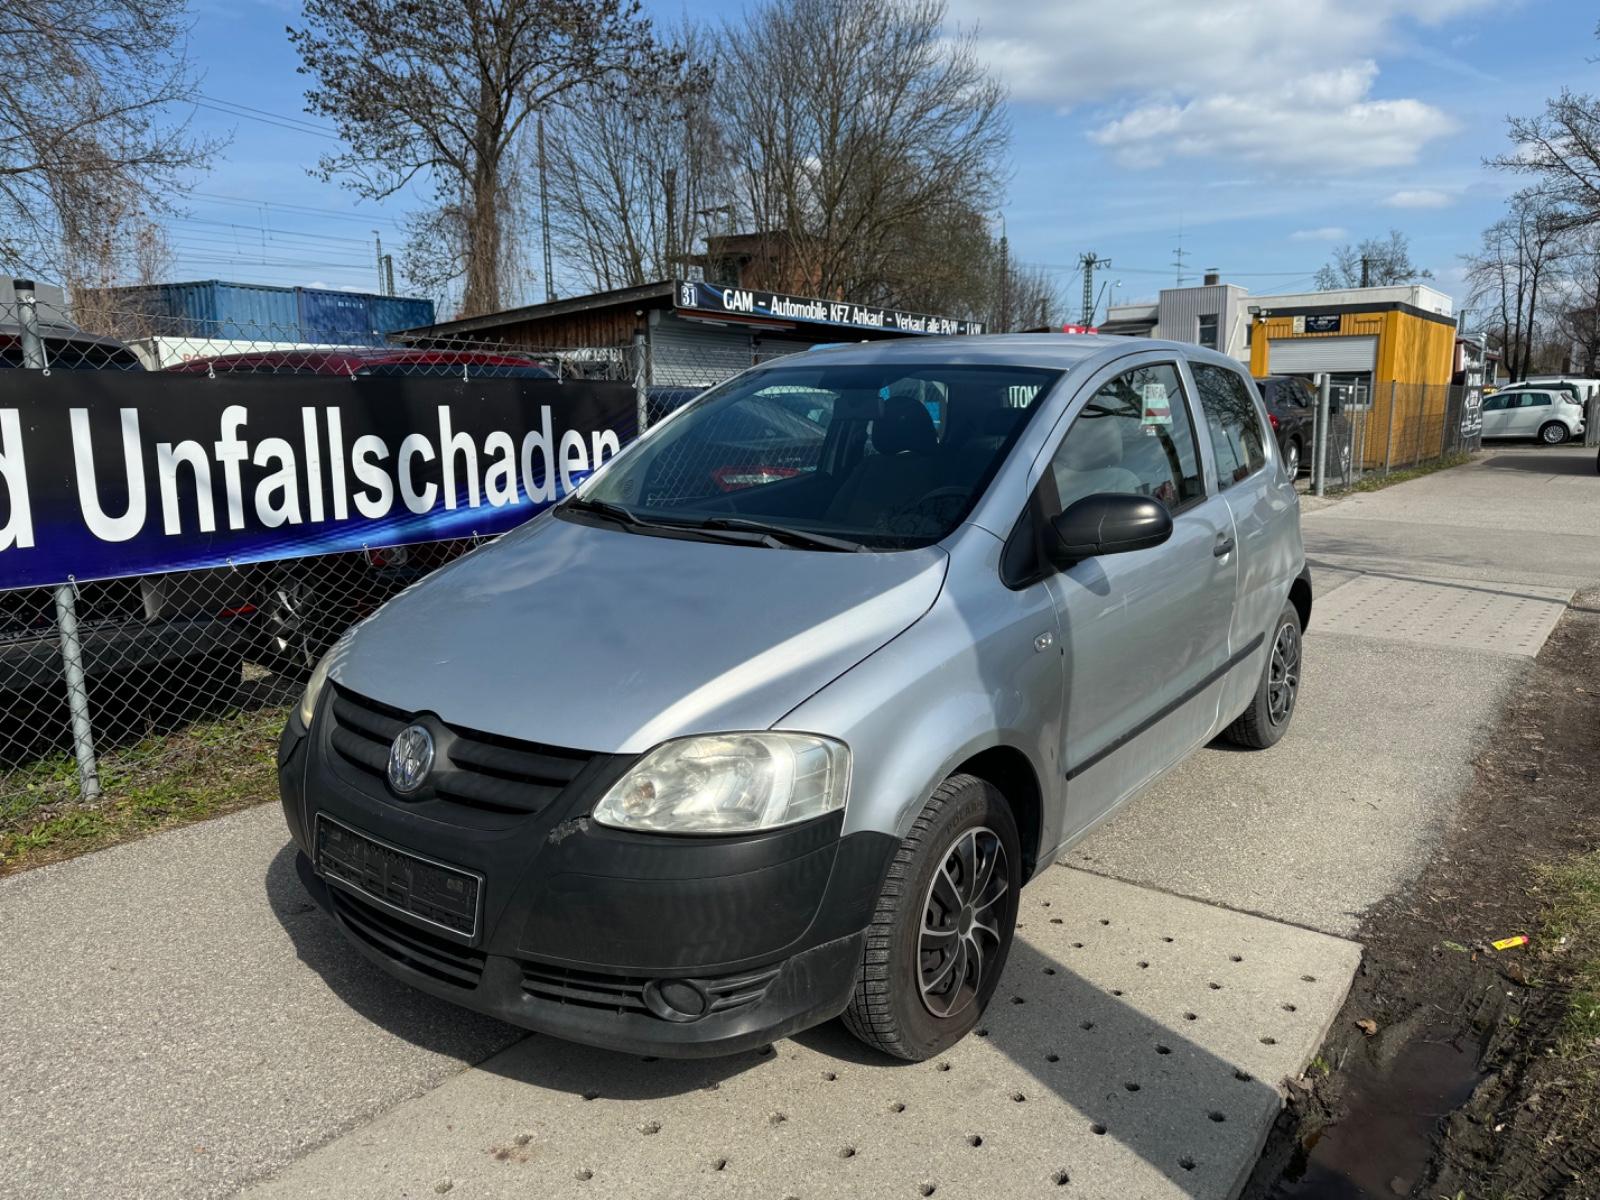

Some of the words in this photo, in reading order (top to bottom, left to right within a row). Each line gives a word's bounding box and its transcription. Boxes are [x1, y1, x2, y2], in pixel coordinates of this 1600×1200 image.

[681, 286, 697, 306] 31
[723, 288, 753, 312] GAM
[770, 296, 828, 321] Automobile
[830, 303, 850, 324] KFZ
[852, 307, 885, 327] Ankauf
[895, 313, 926, 333] Verkauf
[926, 319, 941, 334] alle
[70, 405, 620, 542] Unfallschaden
